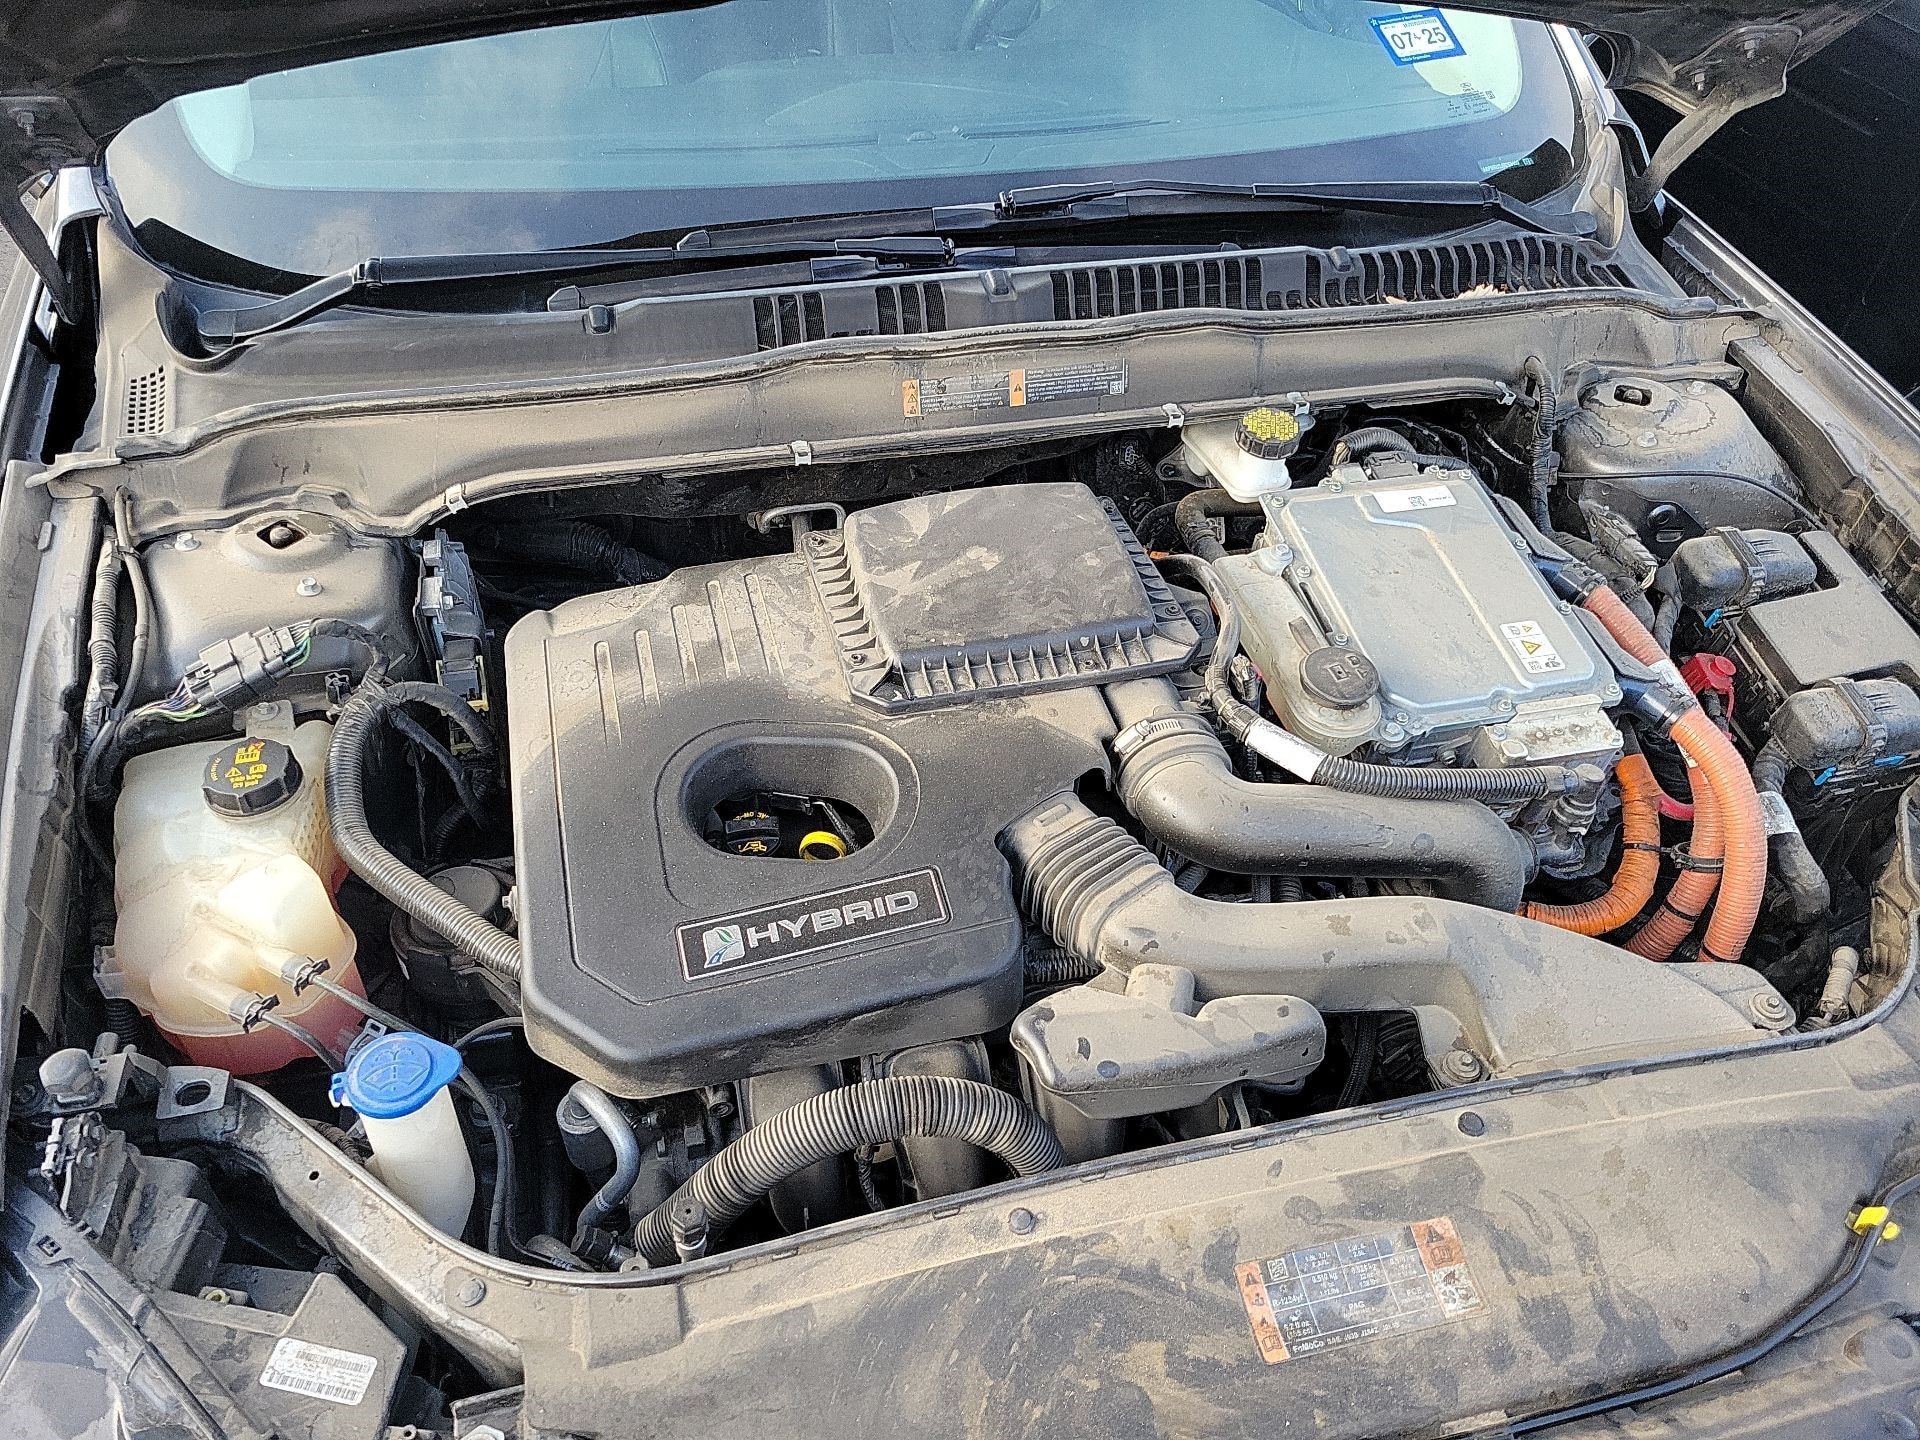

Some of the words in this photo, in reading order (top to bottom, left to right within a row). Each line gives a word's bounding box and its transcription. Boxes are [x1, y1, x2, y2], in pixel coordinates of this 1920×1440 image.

[1390, 31, 1413, 50] 07
[1421, 26, 1447, 45] 25
[746, 890, 919, 949] HYBRID
